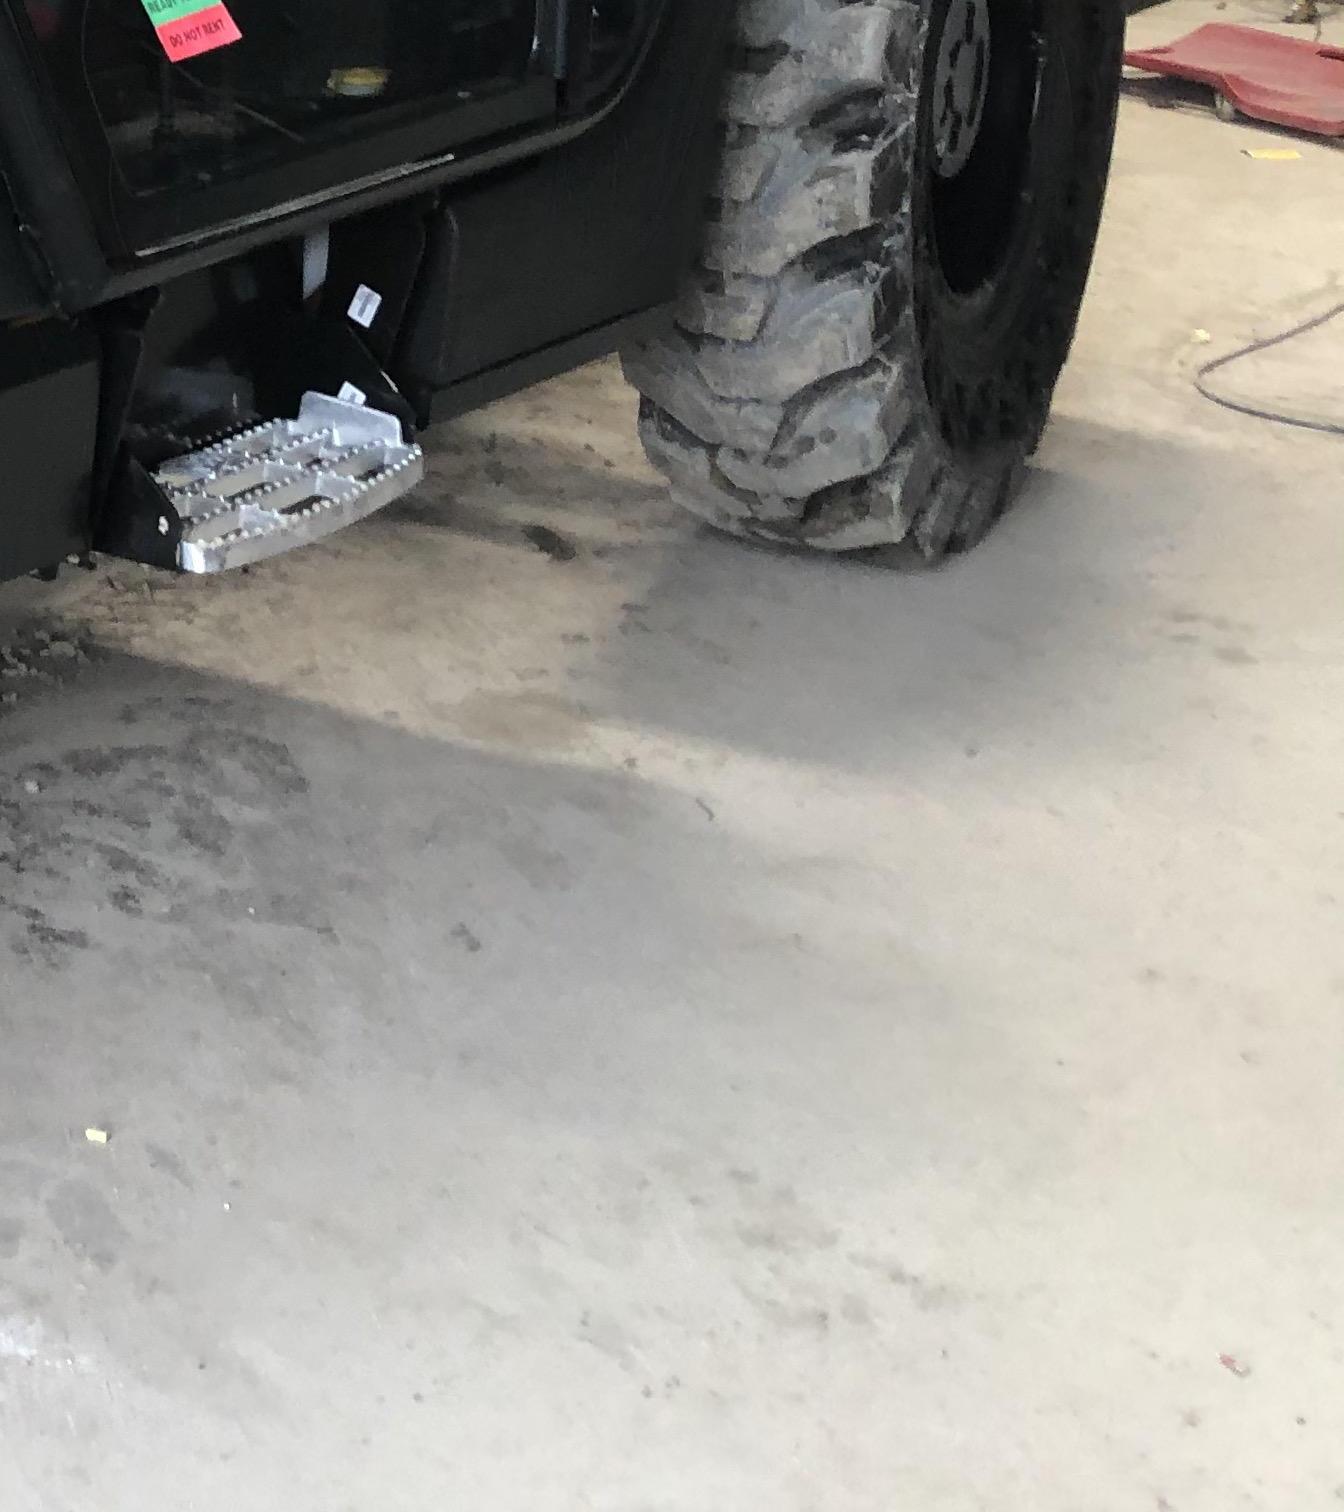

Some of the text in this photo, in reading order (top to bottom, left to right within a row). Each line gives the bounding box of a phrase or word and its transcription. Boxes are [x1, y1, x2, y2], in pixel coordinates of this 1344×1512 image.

[169, 18, 225, 48] DO NOT RENT
